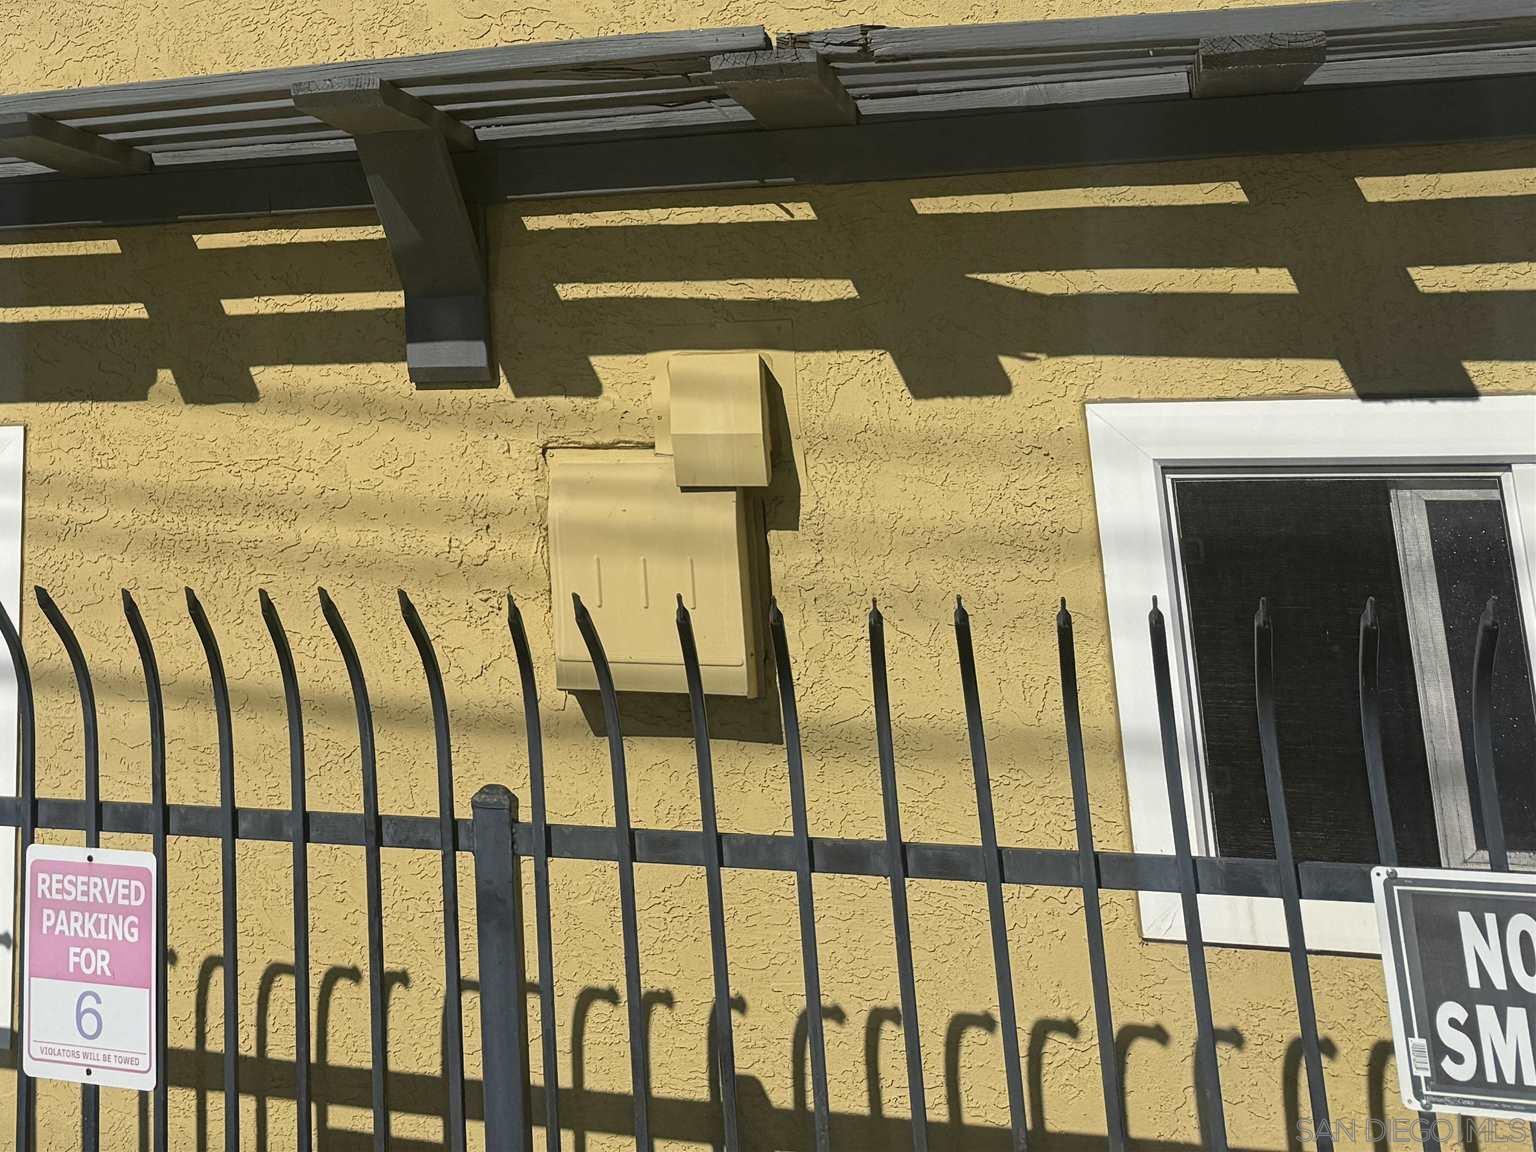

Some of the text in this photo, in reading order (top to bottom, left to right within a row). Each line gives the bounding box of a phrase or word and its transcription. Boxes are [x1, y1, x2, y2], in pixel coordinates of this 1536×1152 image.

[37, 872, 146, 907] RESERVED
[42, 908, 139, 943] PARKING
[68, 947, 112, 977] FOR
[75, 990, 103, 1041] 6
[40, 1046, 140, 1066] VIOLATORS WILL BE TOWED
